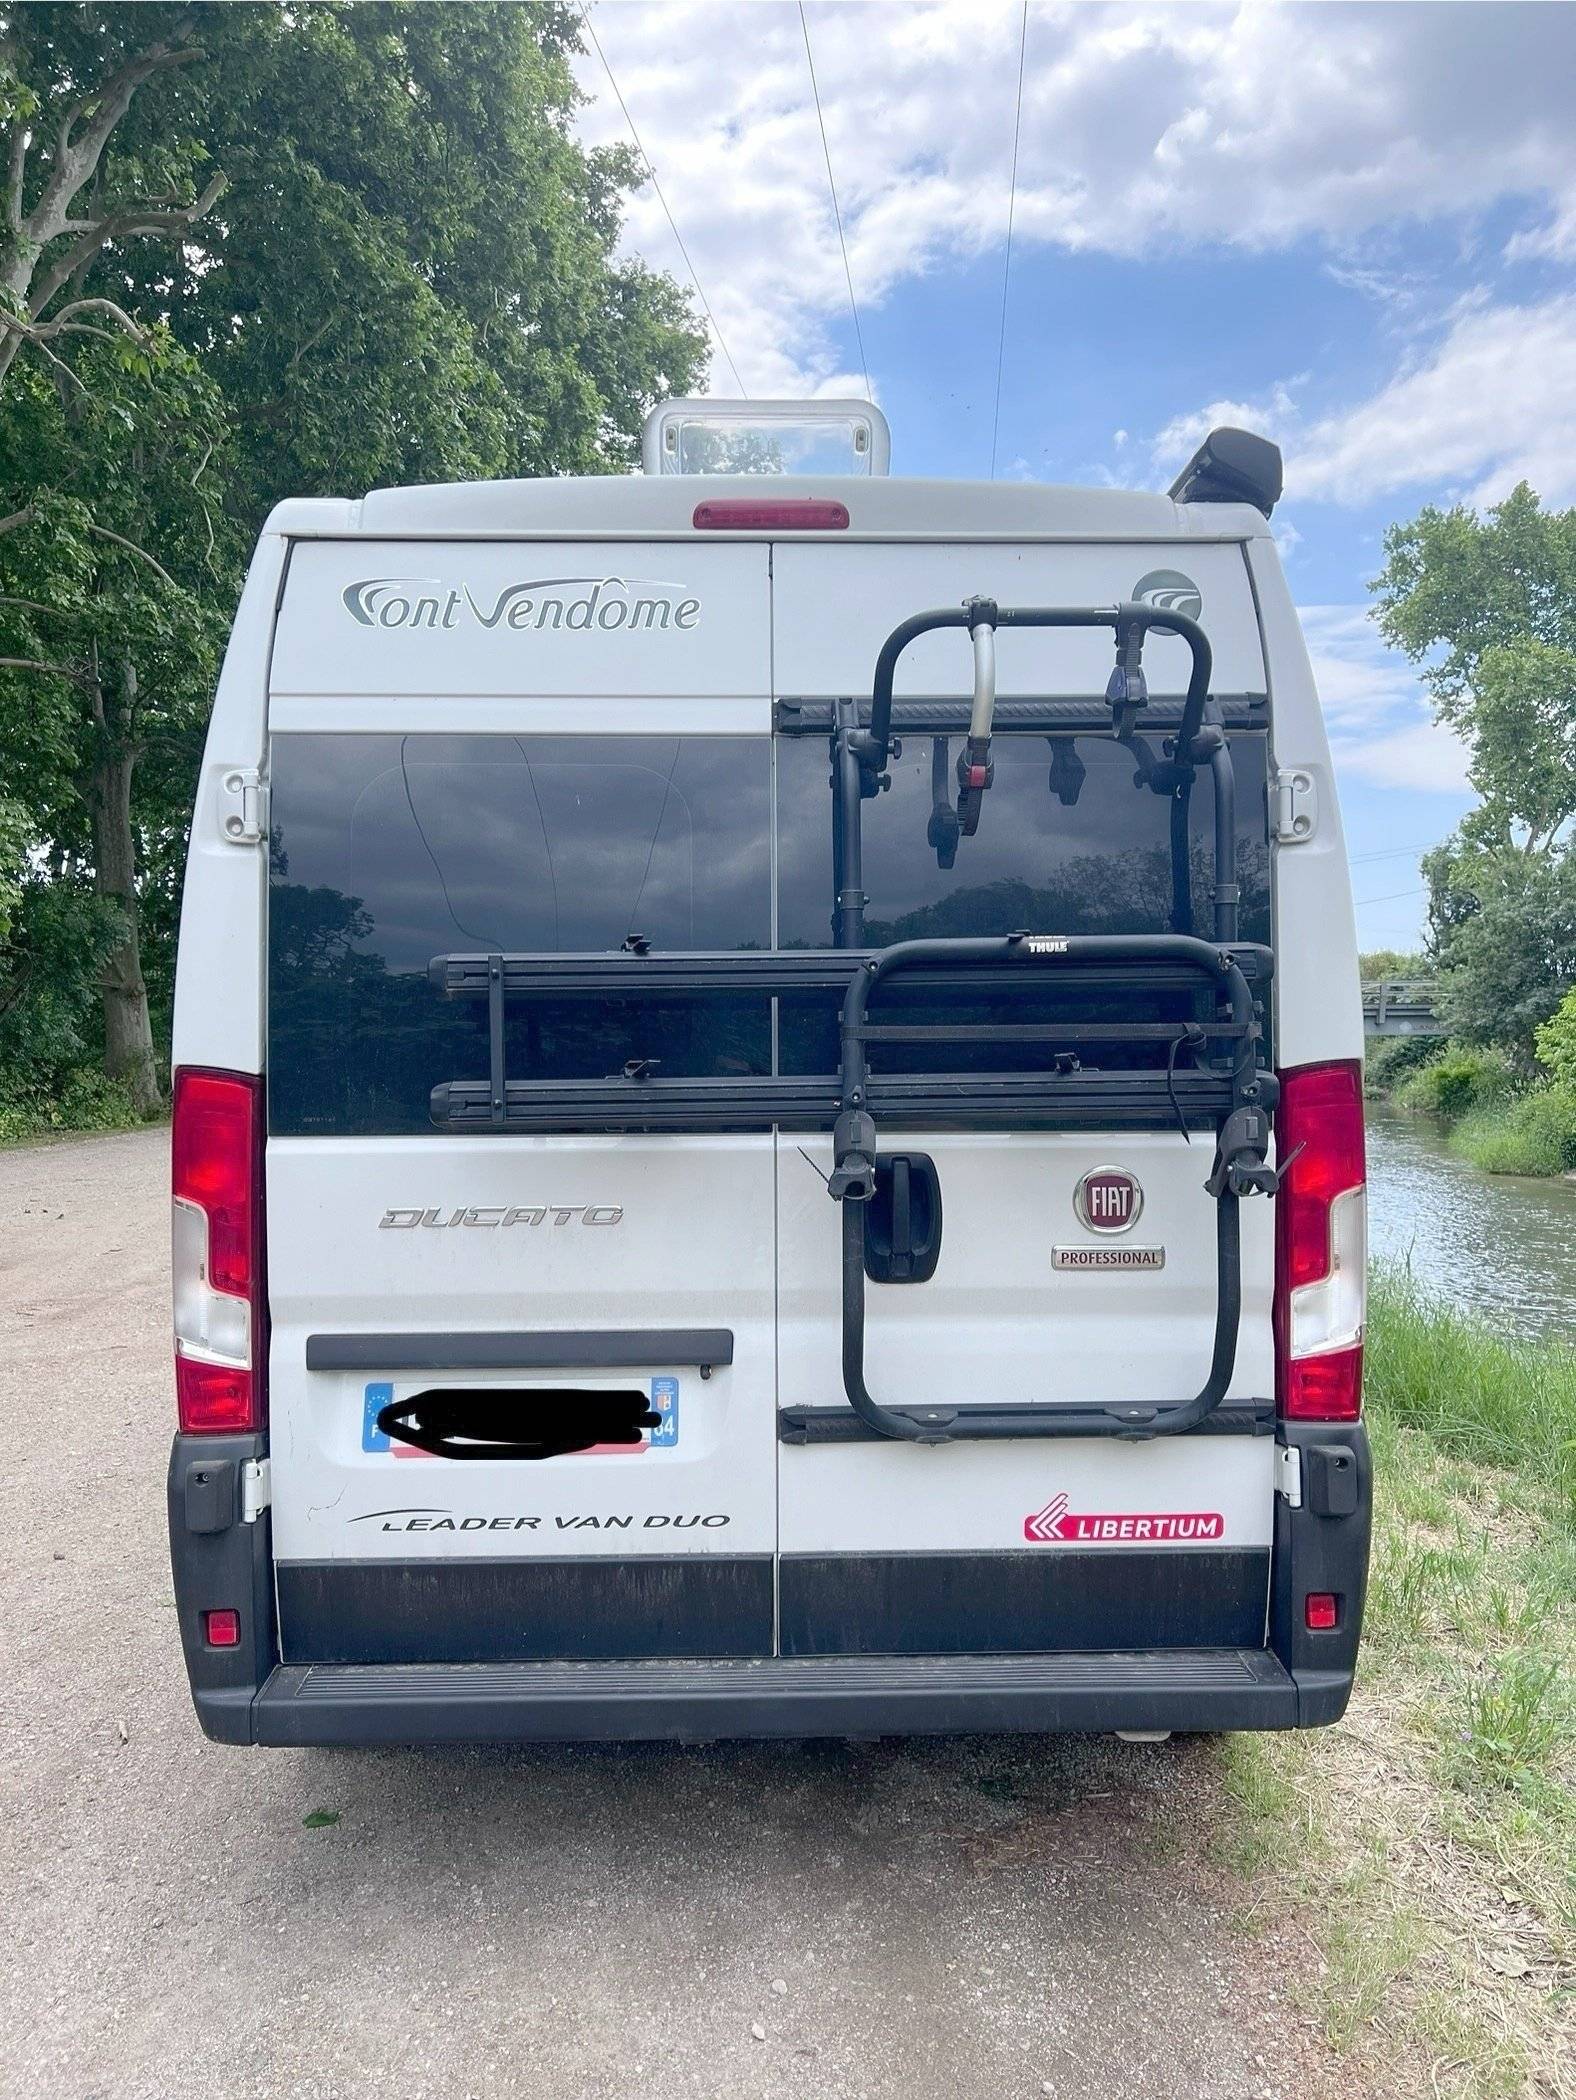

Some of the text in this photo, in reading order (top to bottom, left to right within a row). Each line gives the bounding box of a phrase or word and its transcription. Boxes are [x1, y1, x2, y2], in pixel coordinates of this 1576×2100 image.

[1028, 941, 1069, 953] THULE
[1091, 1186, 1131, 1217] FIAT
[377, 1205, 624, 1228] DUCATO
[1060, 1252, 1159, 1265] PROFESSIONAL
[381, 1514, 731, 1532] LEADER VAN DUO
[1077, 1518, 1218, 1539] LIBERTIUM
